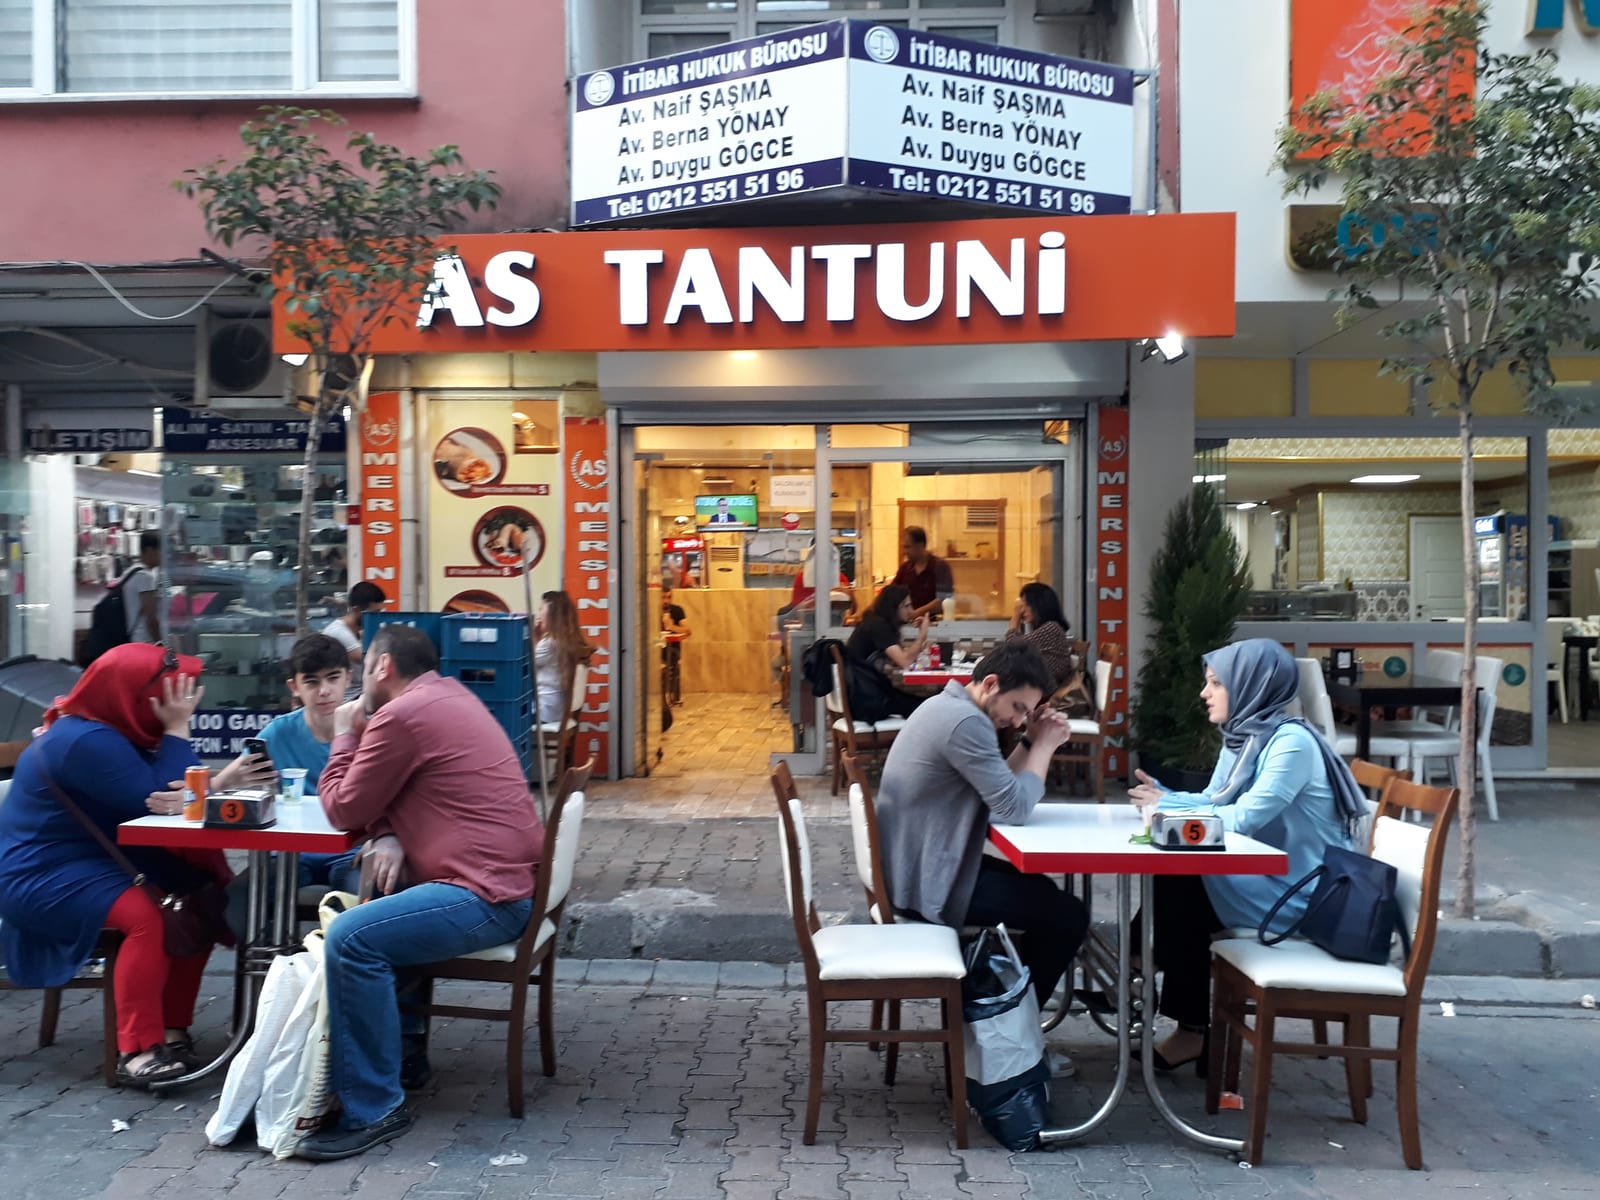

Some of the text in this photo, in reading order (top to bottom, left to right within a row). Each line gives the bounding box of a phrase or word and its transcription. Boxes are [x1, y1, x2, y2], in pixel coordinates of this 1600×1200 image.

[622, 32, 828, 95] İTİBAR HUKUK BÜROSU
[910, 37, 1115, 97] İTİBAR HUKUK BÜROSU
[618, 79, 772, 127] Av. Naif ŞAŞMA
[902, 73, 1066, 119] Av. Naif ŞAŞMA
[618, 105, 790, 157] Av. Berna YÖNAY
[901, 105, 1082, 151] Av. Berna YÖNAY
[617, 134, 793, 185] Av. Duygu GÖGCE
[901, 136, 1086, 181] Av. Duygu GÖGCE
[607, 168, 804, 218] Tel: 0212 551 51 96
[889, 168, 1095, 213] Tel: 0212 551 51 96
[416, 231, 1066, 327] AS TANTUNİ
[206, 438, 299, 450] AKSESUAR
[285, 422, 341, 434] TAR
[370, 423, 390, 436] AS
[1104, 441, 1121, 452] AS
[579, 459, 608, 476] AS
[363, 452, 397, 580] MERSİN
[1098, 471, 1126, 600] MERSİN
[574, 502, 609, 609] MERSİN
[228, 714, 281, 730] GAR
[226, 802, 237, 819] 3
[1189, 823, 1201, 841] 5
